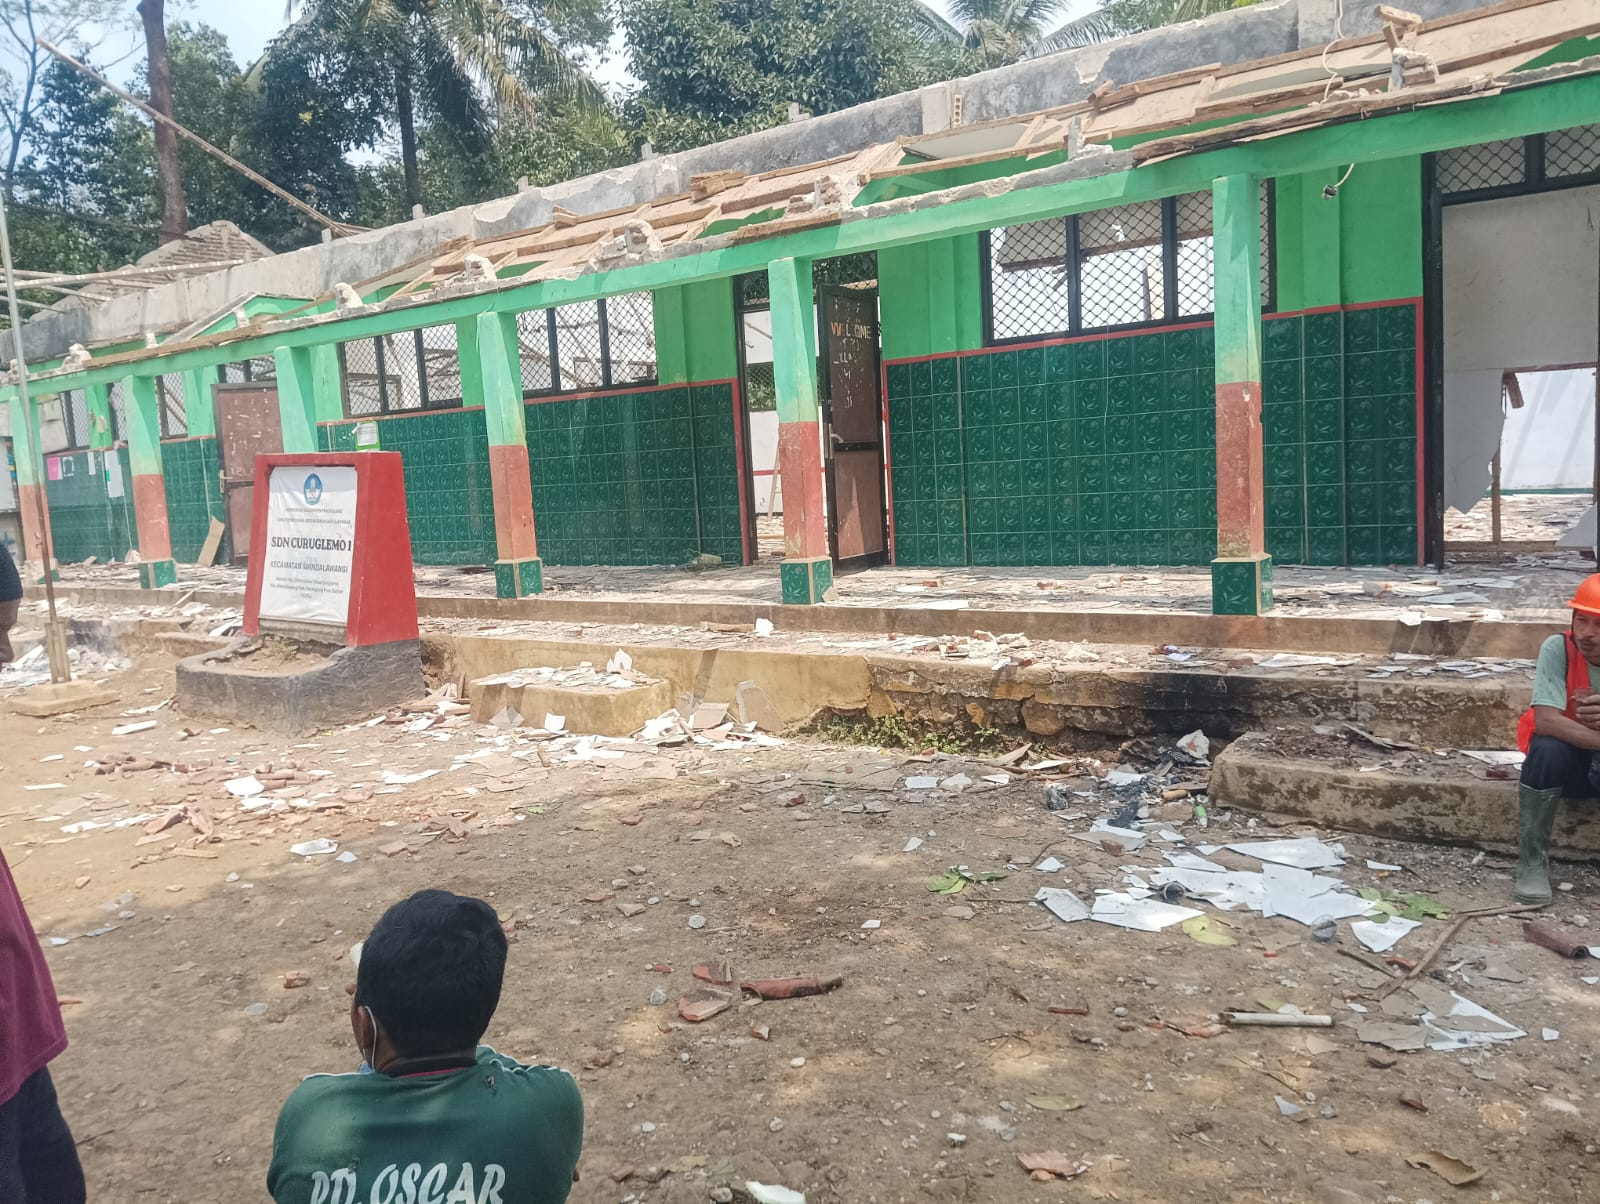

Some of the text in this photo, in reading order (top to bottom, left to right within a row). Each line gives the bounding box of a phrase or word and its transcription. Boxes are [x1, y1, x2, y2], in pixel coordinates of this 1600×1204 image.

[271, 536, 352, 551] SDN CURUGLEMO 1
[370, 1162, 506, 1204] OSCAR
